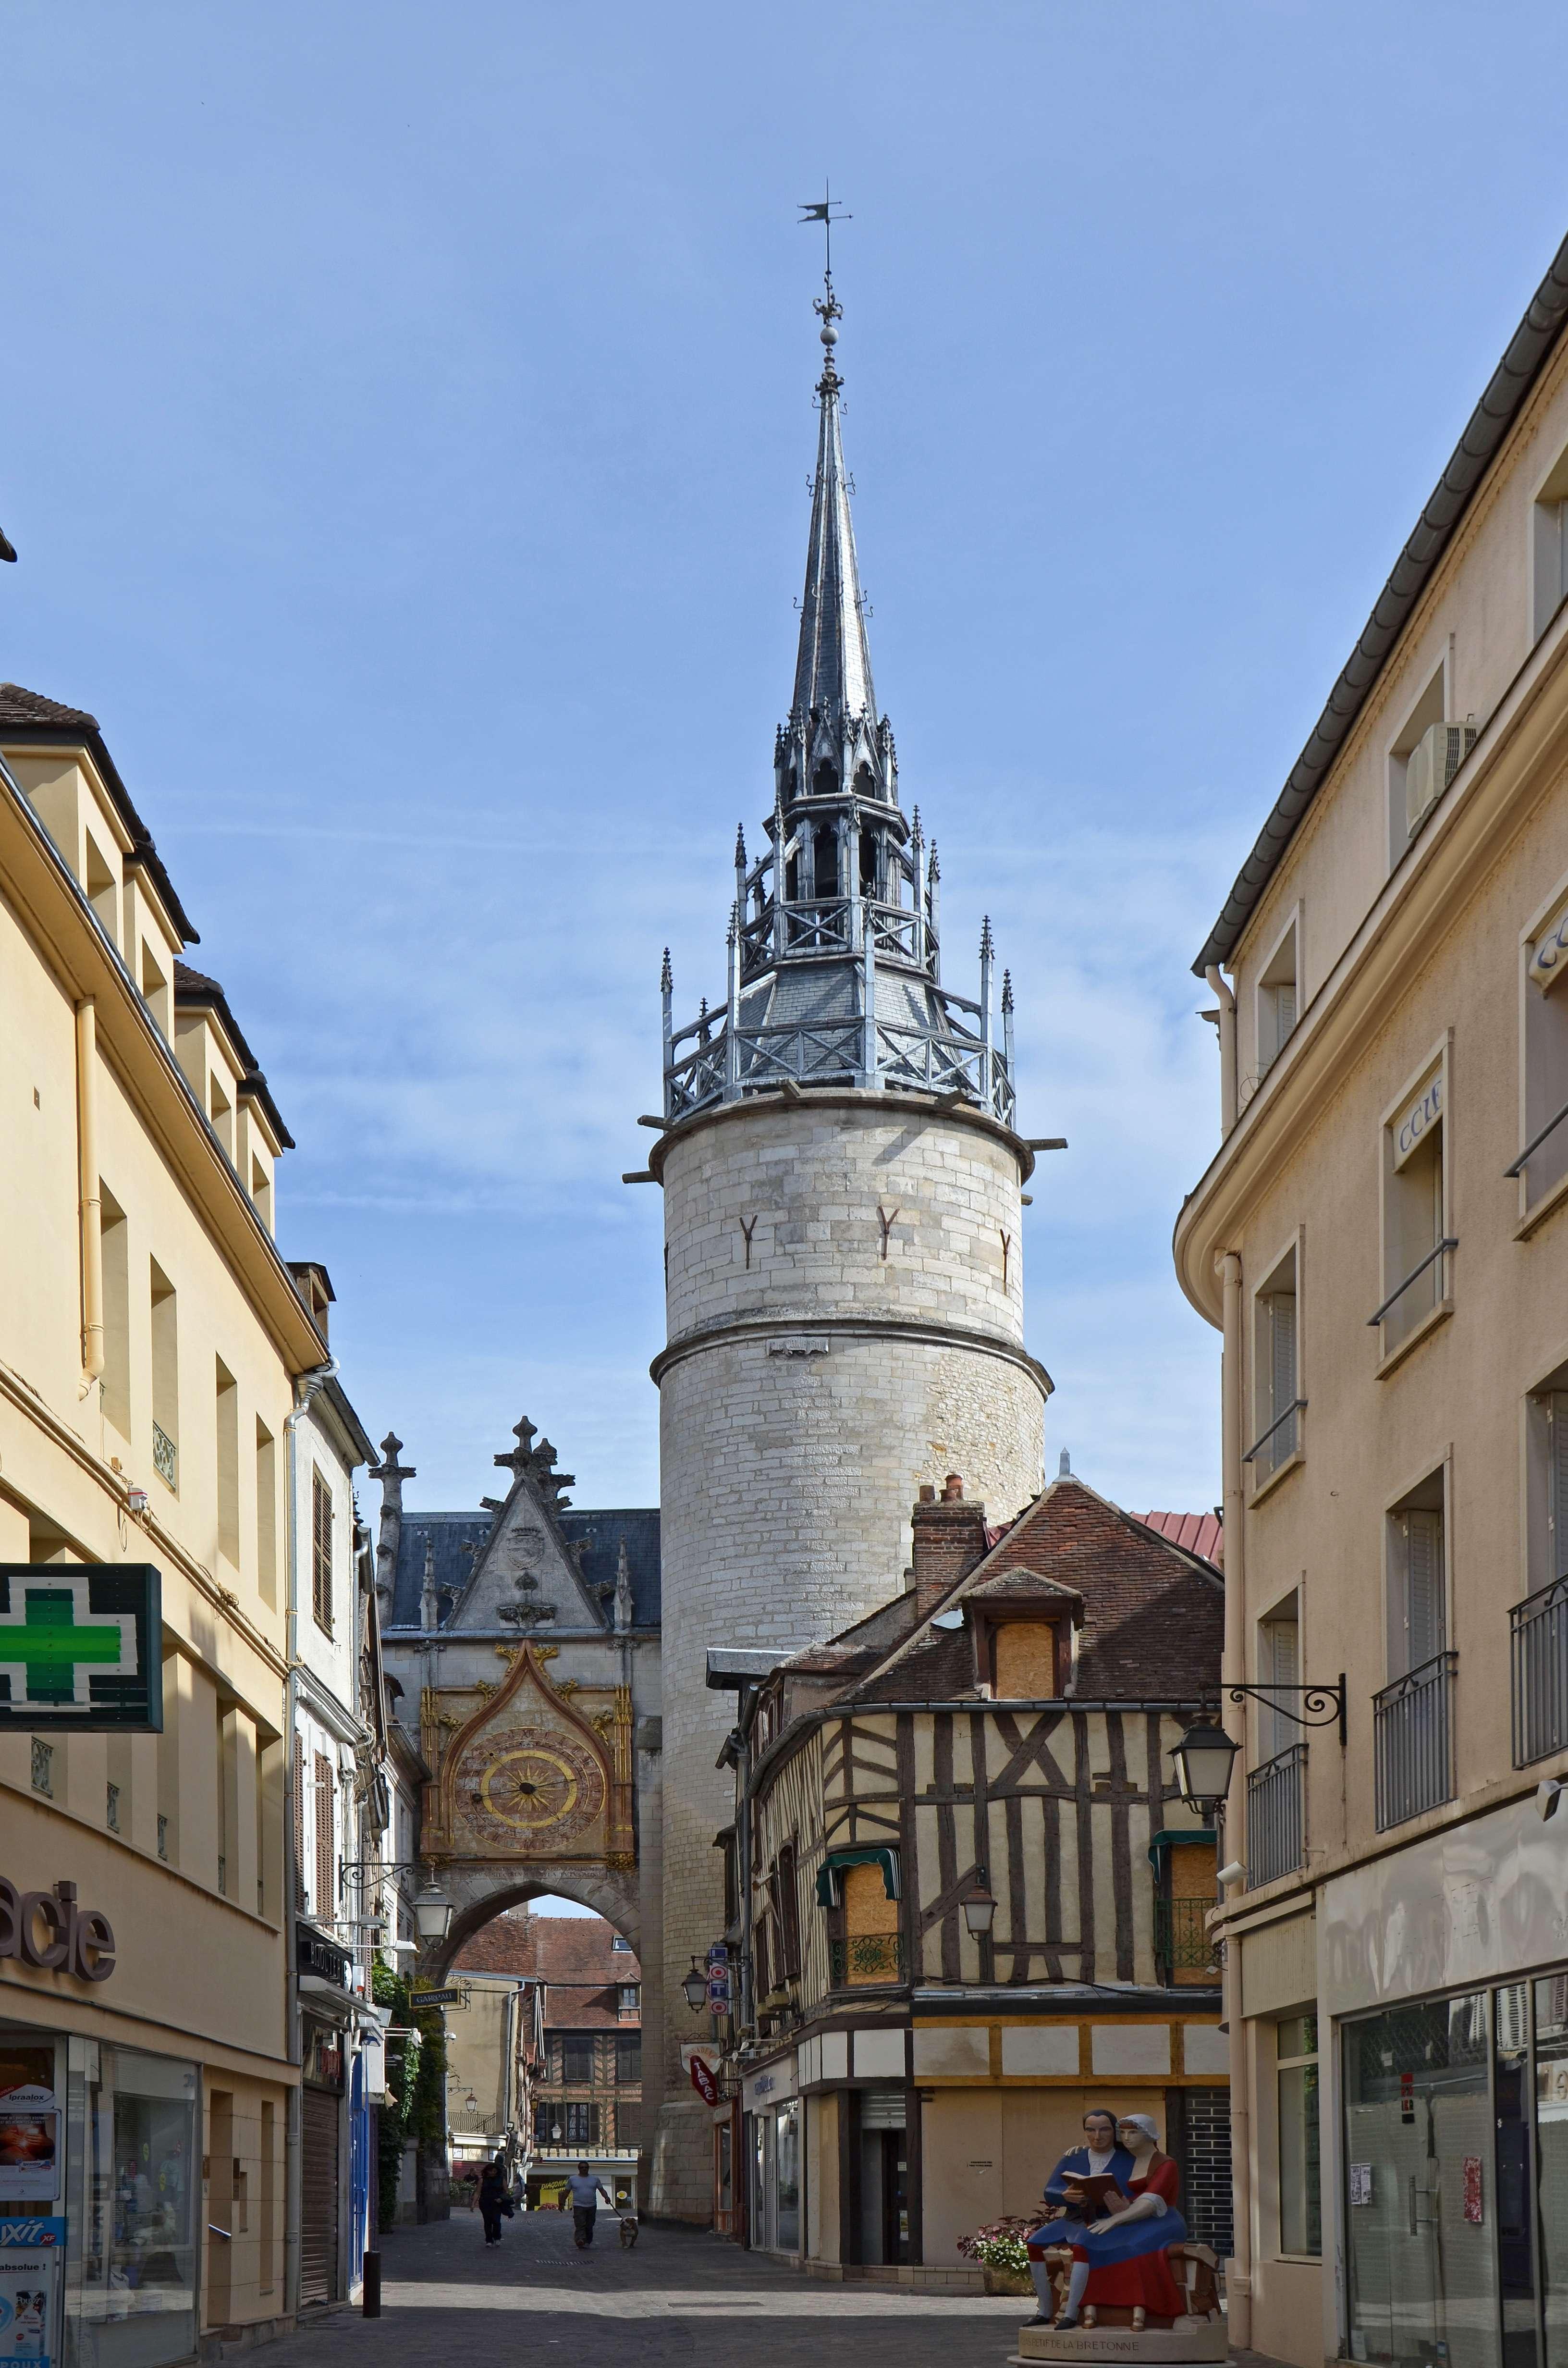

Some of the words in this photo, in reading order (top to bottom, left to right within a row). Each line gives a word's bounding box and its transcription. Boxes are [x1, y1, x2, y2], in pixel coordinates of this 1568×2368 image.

[694, 2062, 714, 2100] TABAC
[39, 2235, 56, 2245] XF
[1052, 2340, 1061, 2348] DE
[1063, 2341, 1074, 2349] LA
[1077, 2341, 1139, 2351] BRETONNE
